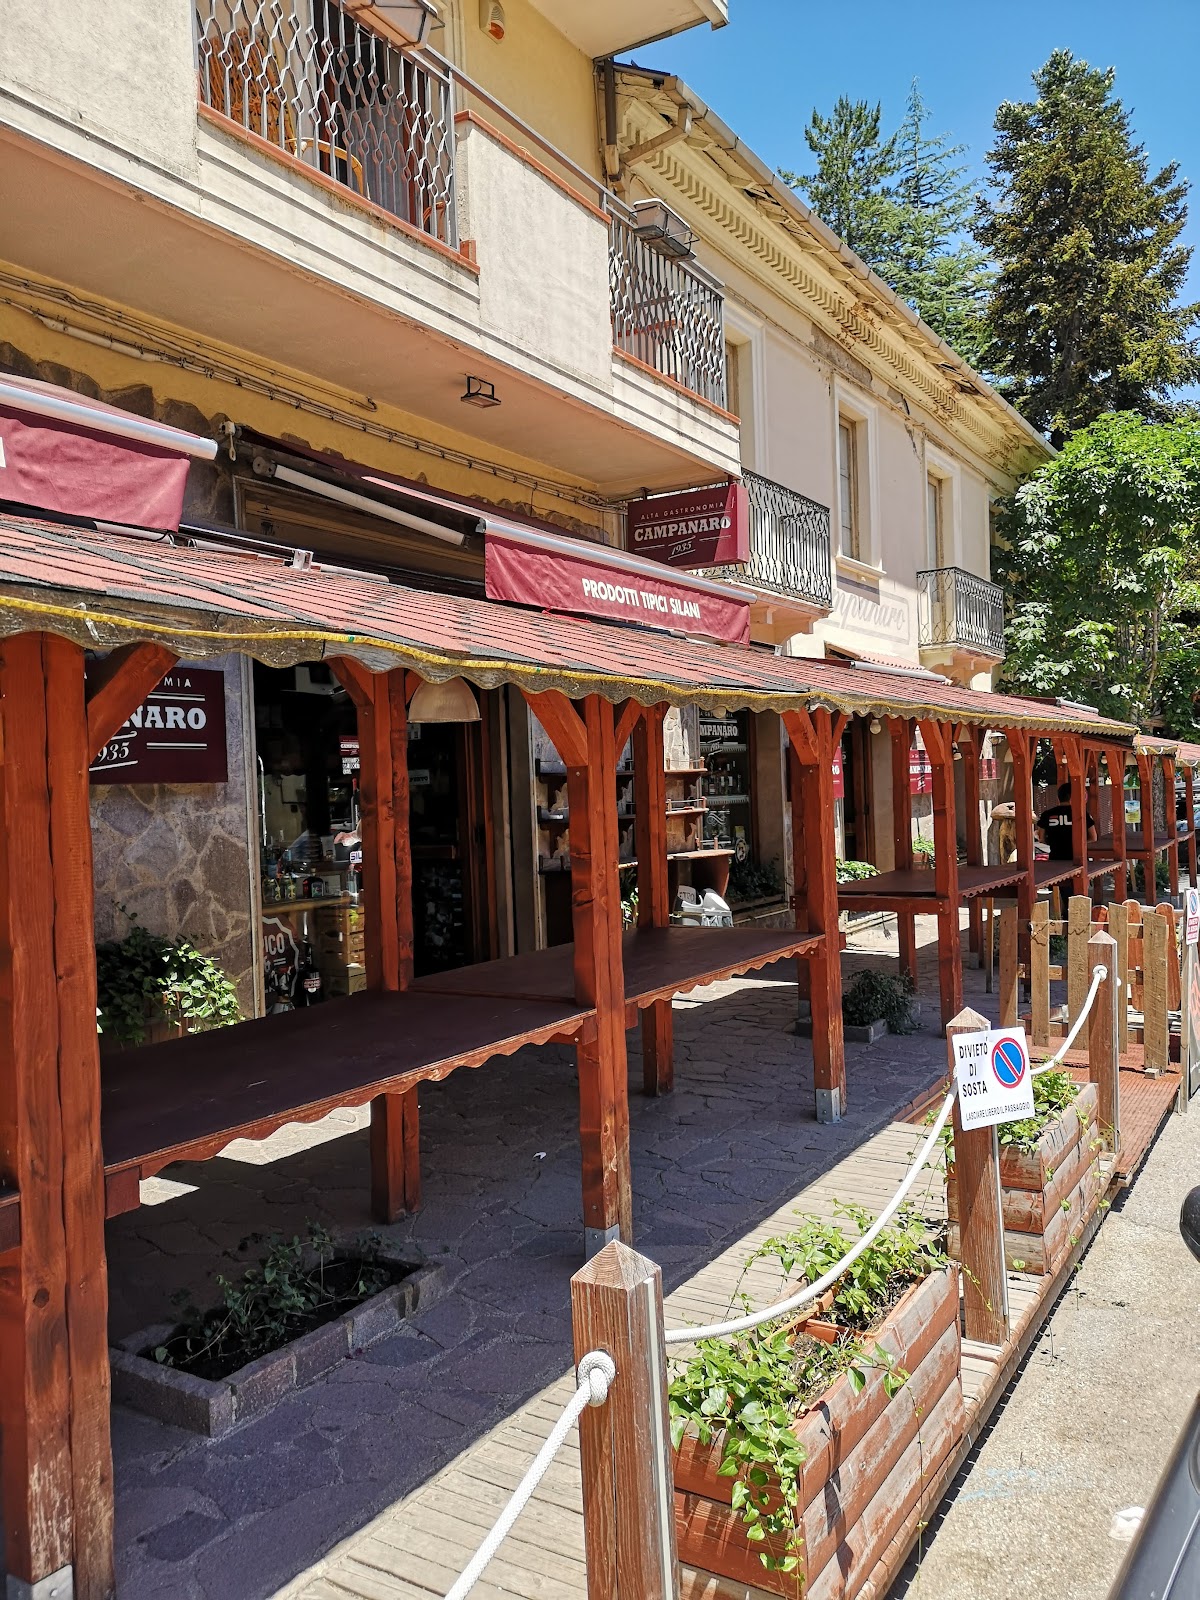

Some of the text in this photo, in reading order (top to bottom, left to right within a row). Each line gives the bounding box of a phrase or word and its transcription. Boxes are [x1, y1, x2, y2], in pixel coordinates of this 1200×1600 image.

[640, 501, 725, 521] ALTA GASTRONOMIA
[634, 516, 732, 542] CAMPANARO
[670, 541, 692, 556] 1935
[581, 577, 701, 619] PRODOTTI TIPICI SILANI
[700, 724, 738, 737] MPANARO
[97, 741, 130, 762] 935
[1048, 814, 1073, 827] SIL
[959, 1043, 988, 1058] DIVIETO
[969, 1063, 977, 1076] DI
[962, 1081, 987, 1097] SOSTA
